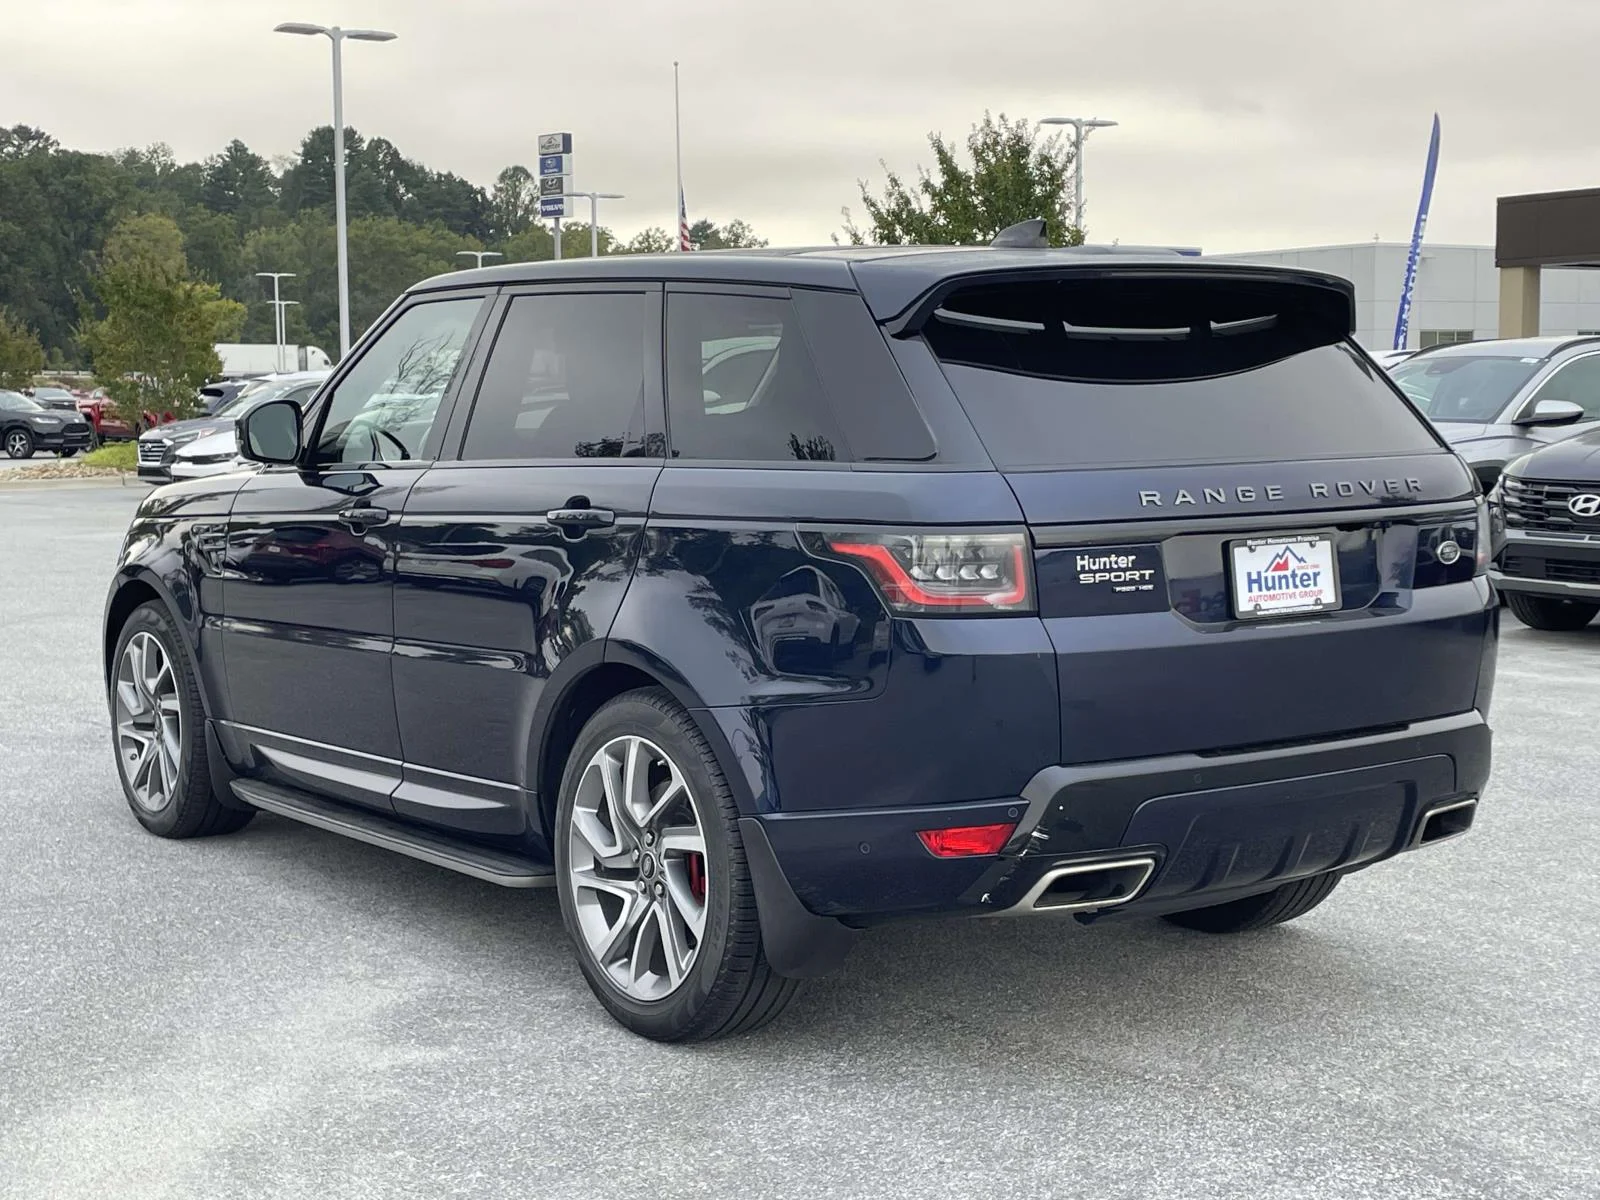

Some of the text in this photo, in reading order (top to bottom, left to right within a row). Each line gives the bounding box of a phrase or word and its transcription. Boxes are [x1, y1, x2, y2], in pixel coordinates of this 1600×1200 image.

[541, 203, 564, 212] VOLVO
[1139, 477, 1423, 507] RANGE ROVER
[1076, 554, 1137, 571] Hunter
[1079, 569, 1155, 584] SPORT
[1246, 568, 1321, 593] Hunter
[1248, 589, 1324, 603] AUTOMOTIVE GROUP
